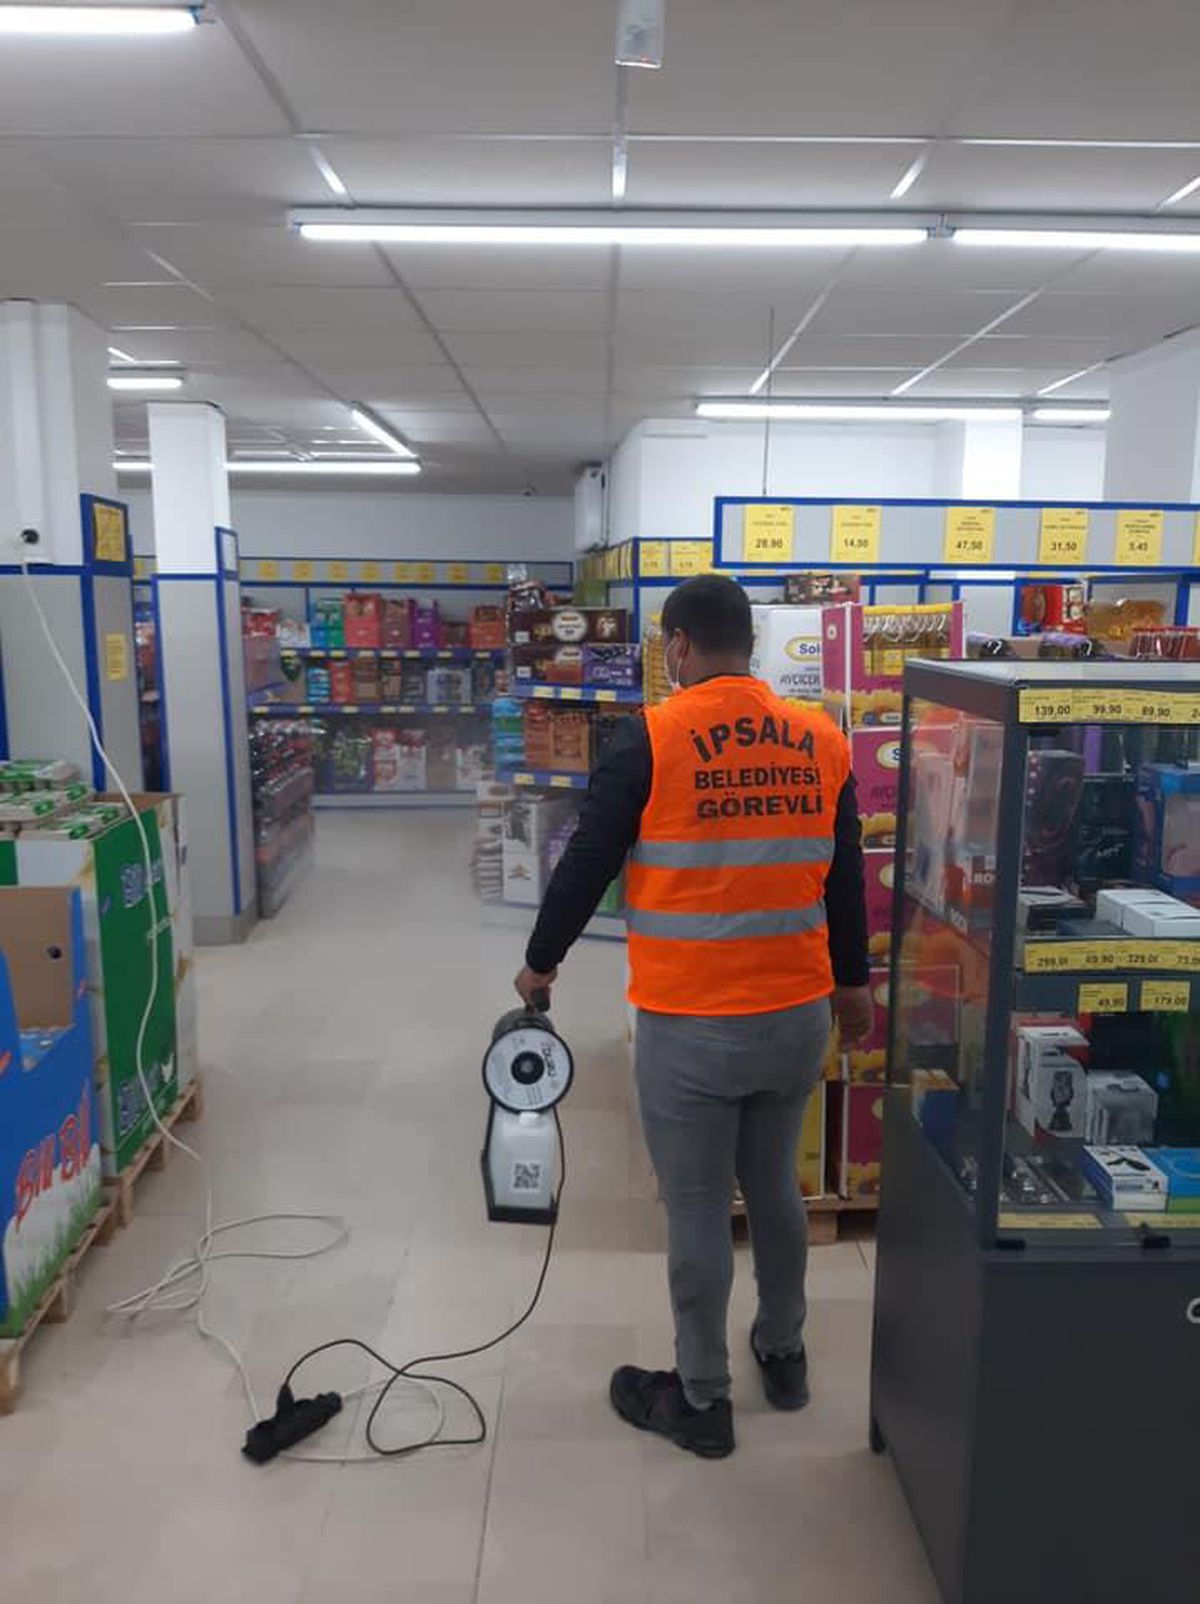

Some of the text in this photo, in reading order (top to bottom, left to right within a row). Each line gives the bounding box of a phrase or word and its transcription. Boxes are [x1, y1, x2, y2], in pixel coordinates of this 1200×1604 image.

[690, 715, 814, 762] İPSALA
[694, 761, 822, 790] BELEDİYESİ
[697, 789, 823, 819] GÖREVLİ
